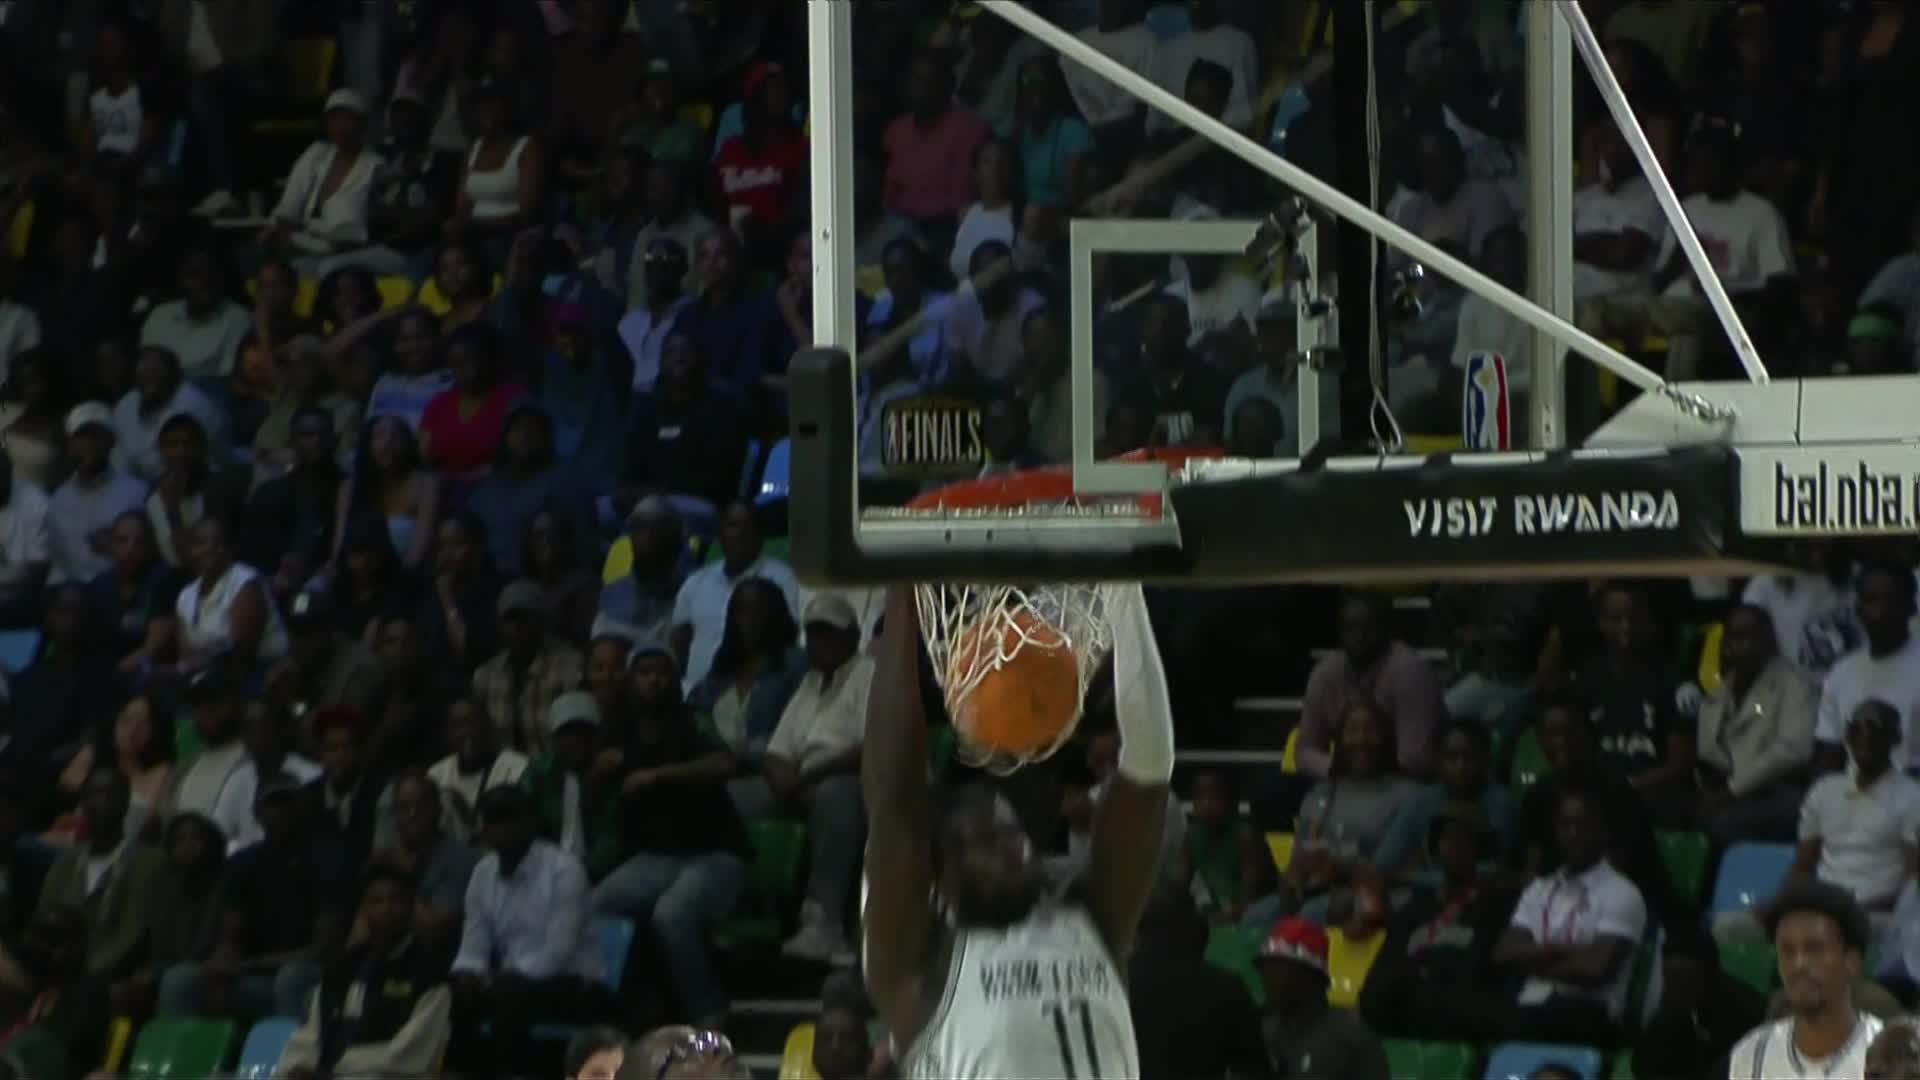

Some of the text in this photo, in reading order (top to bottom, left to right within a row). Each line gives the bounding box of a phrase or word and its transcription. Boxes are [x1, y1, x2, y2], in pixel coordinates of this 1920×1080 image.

[901, 409, 982, 462] FINALS
[1403, 489, 1680, 537] VISIT RWANDA
